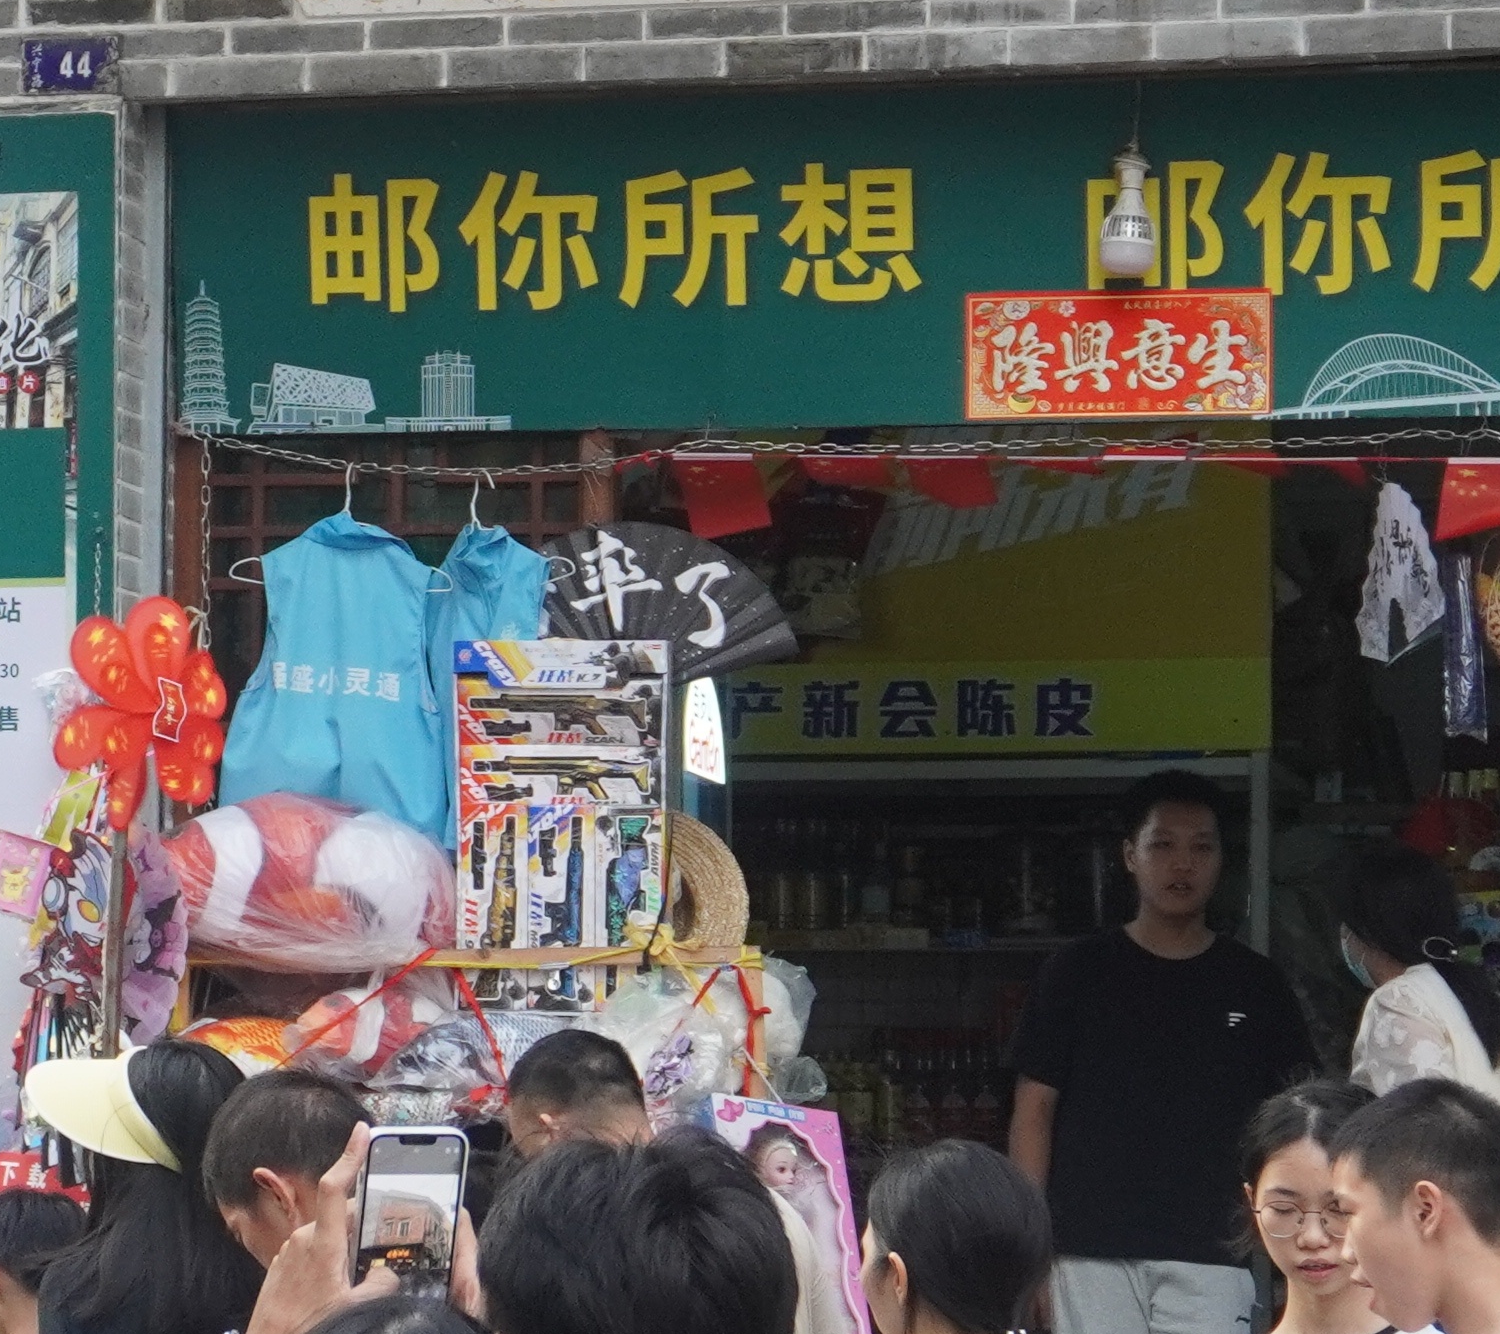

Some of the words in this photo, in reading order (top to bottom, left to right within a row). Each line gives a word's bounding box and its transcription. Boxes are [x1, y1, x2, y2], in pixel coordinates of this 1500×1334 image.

[59, 50, 92, 78] 44
[308, 163, 923, 312] 邮你所想
